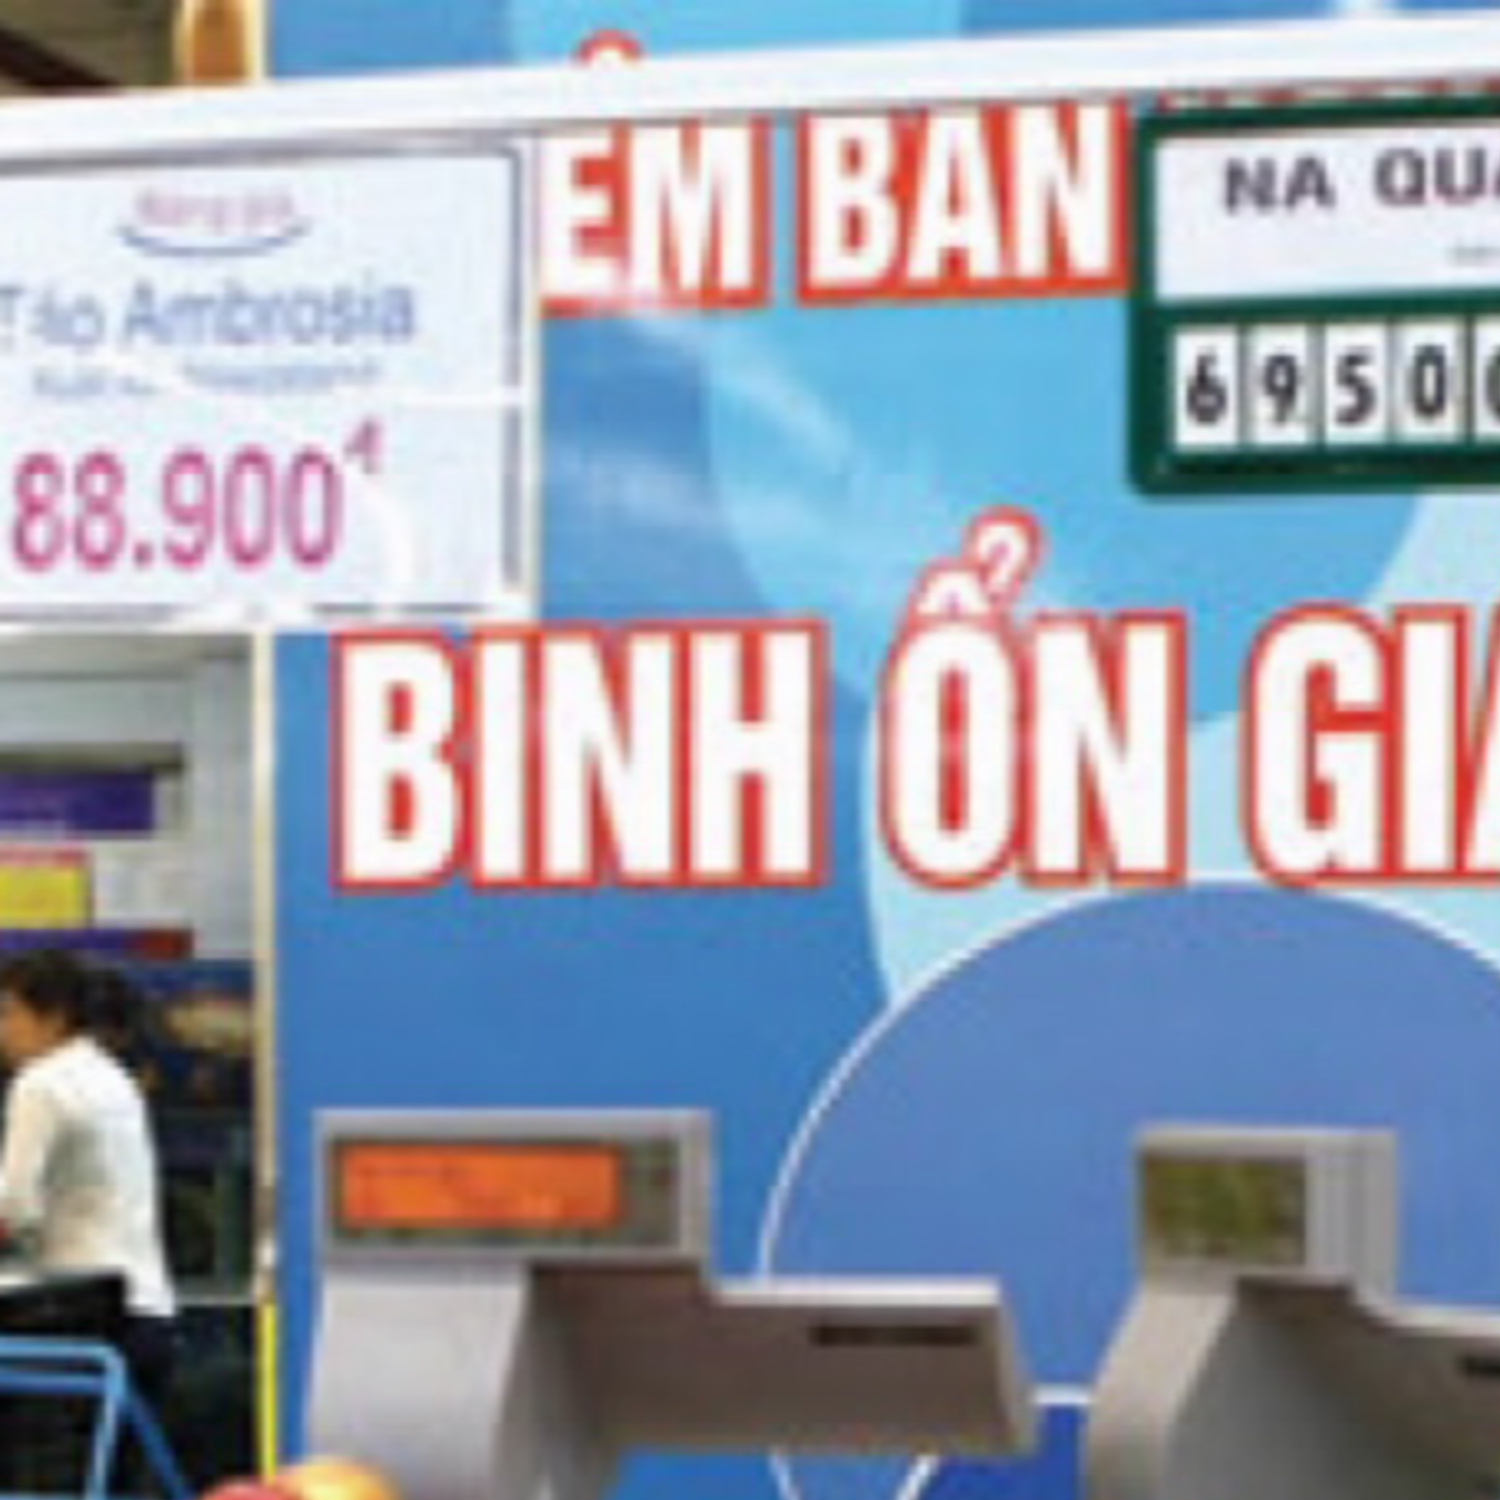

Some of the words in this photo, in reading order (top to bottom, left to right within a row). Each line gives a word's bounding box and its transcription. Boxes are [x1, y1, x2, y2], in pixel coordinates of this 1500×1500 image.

[1223, 150, 1337, 216] NA
[122, 274, 416, 348] Ambrosia
[874, 504, 1192, 892] ỔN
